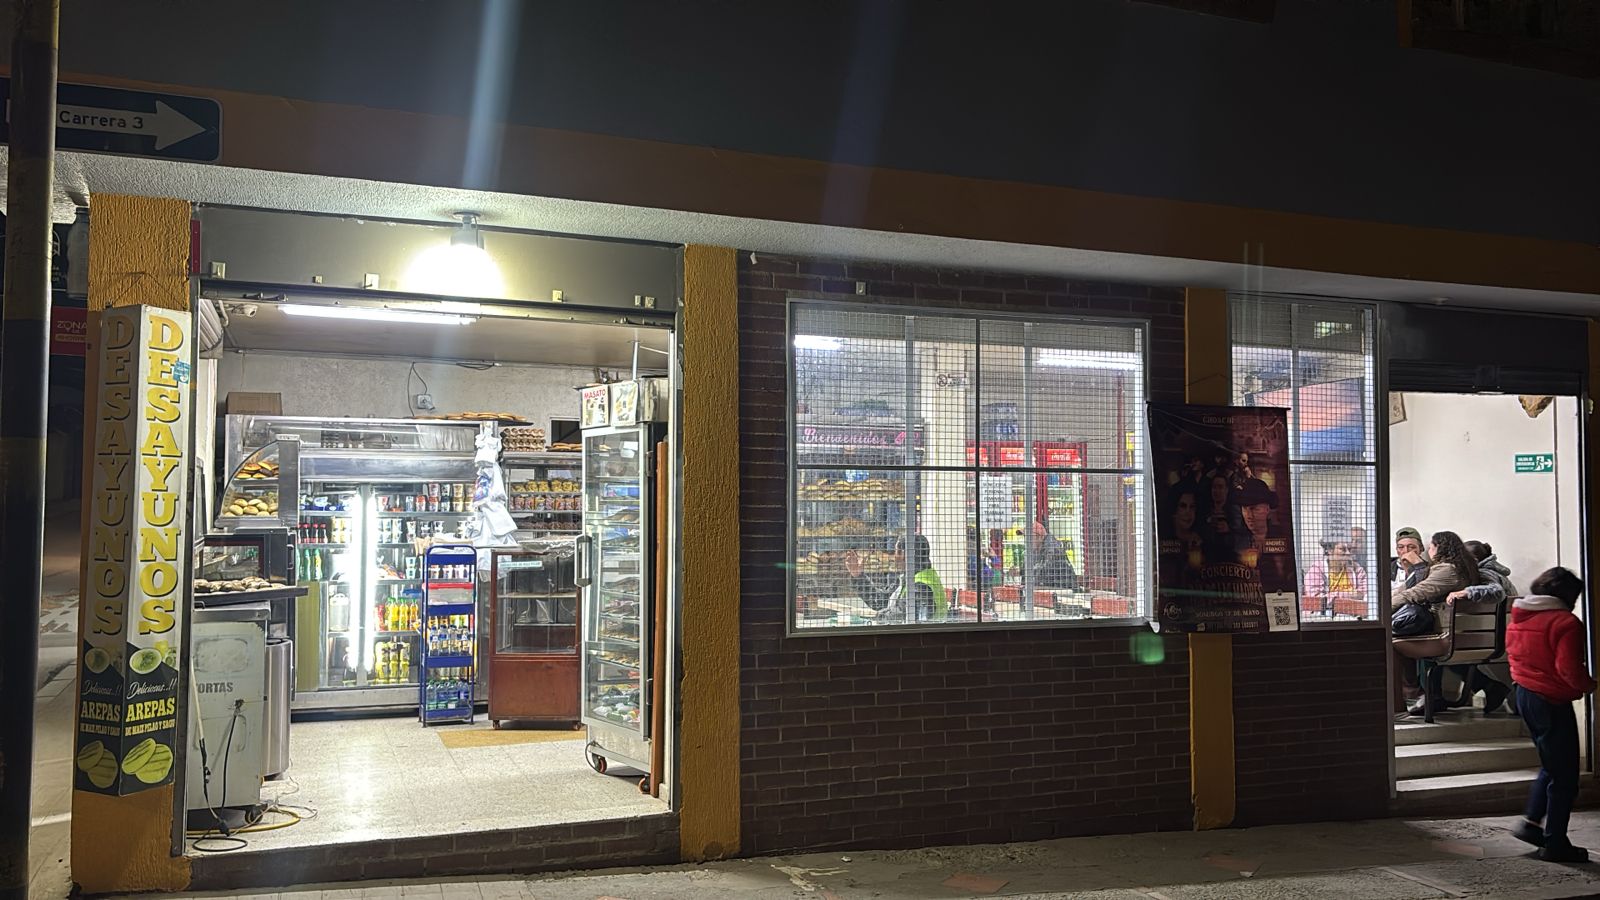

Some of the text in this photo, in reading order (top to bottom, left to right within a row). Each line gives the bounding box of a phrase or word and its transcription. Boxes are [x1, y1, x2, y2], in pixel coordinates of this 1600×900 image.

[59, 111, 144, 129] Carrera 3
[57, 320, 88, 330] ZONA
[584, 388, 606, 398] MASATO
[93, 315, 135, 635] DESAYUNOS
[139, 315, 184, 634] DESAYUNOS
[80, 701, 121, 722] AREPAS
[125, 697, 175, 722] AREPAS
